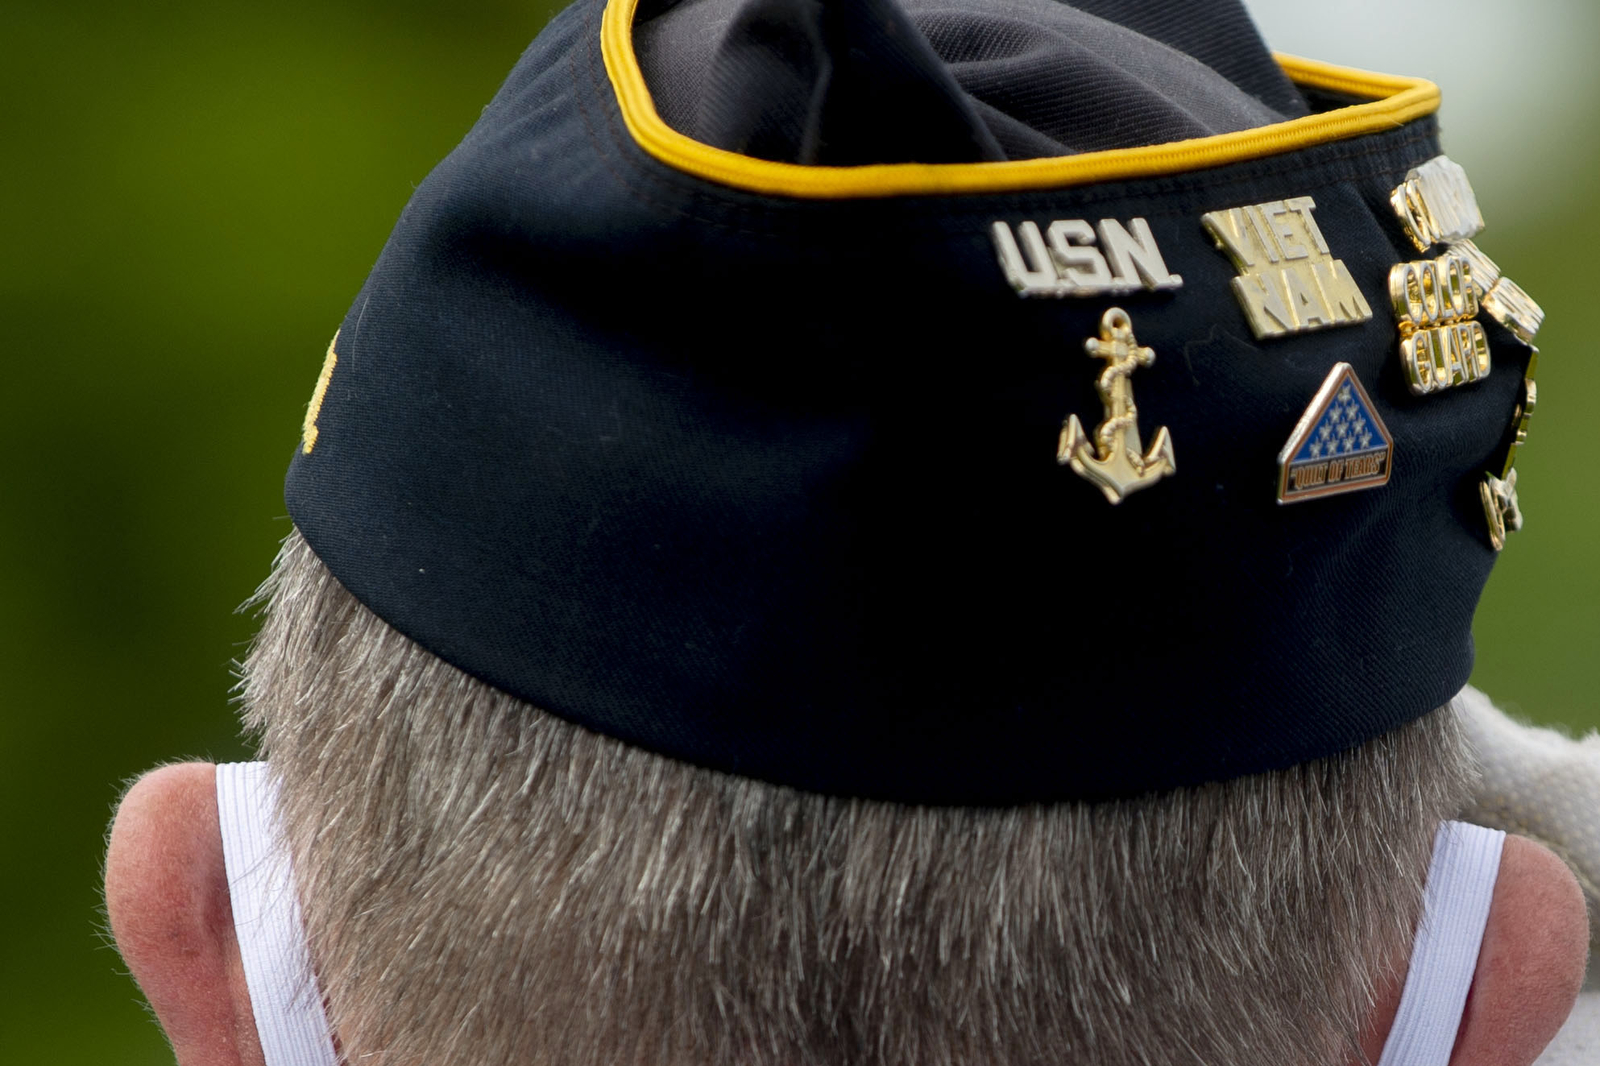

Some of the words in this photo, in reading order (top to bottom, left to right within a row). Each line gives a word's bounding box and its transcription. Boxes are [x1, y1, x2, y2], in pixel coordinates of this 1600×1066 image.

[1201, 196, 1330, 267] VIET
[1230, 259, 1373, 340] NAM
[1402, 320, 1491, 394] GUARD
[1328, 459, 1344, 482] OF
